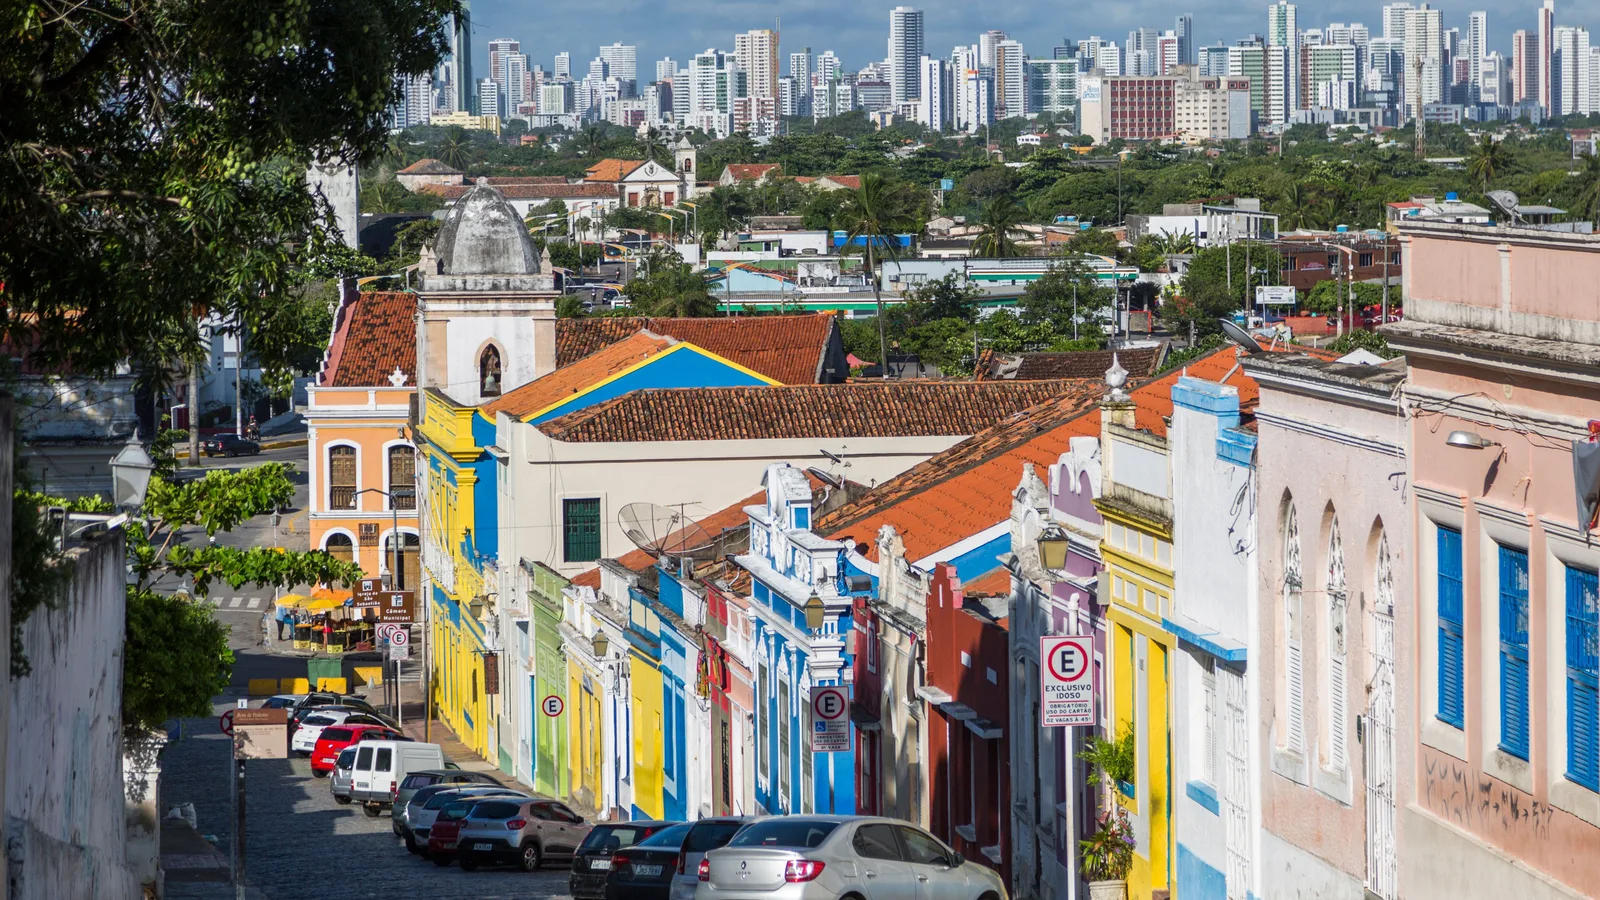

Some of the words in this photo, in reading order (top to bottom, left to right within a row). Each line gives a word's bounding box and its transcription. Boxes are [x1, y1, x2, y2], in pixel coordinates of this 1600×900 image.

[1061, 651, 1075, 672] E
[549, 700, 556, 712] E
[825, 697, 835, 712] E
